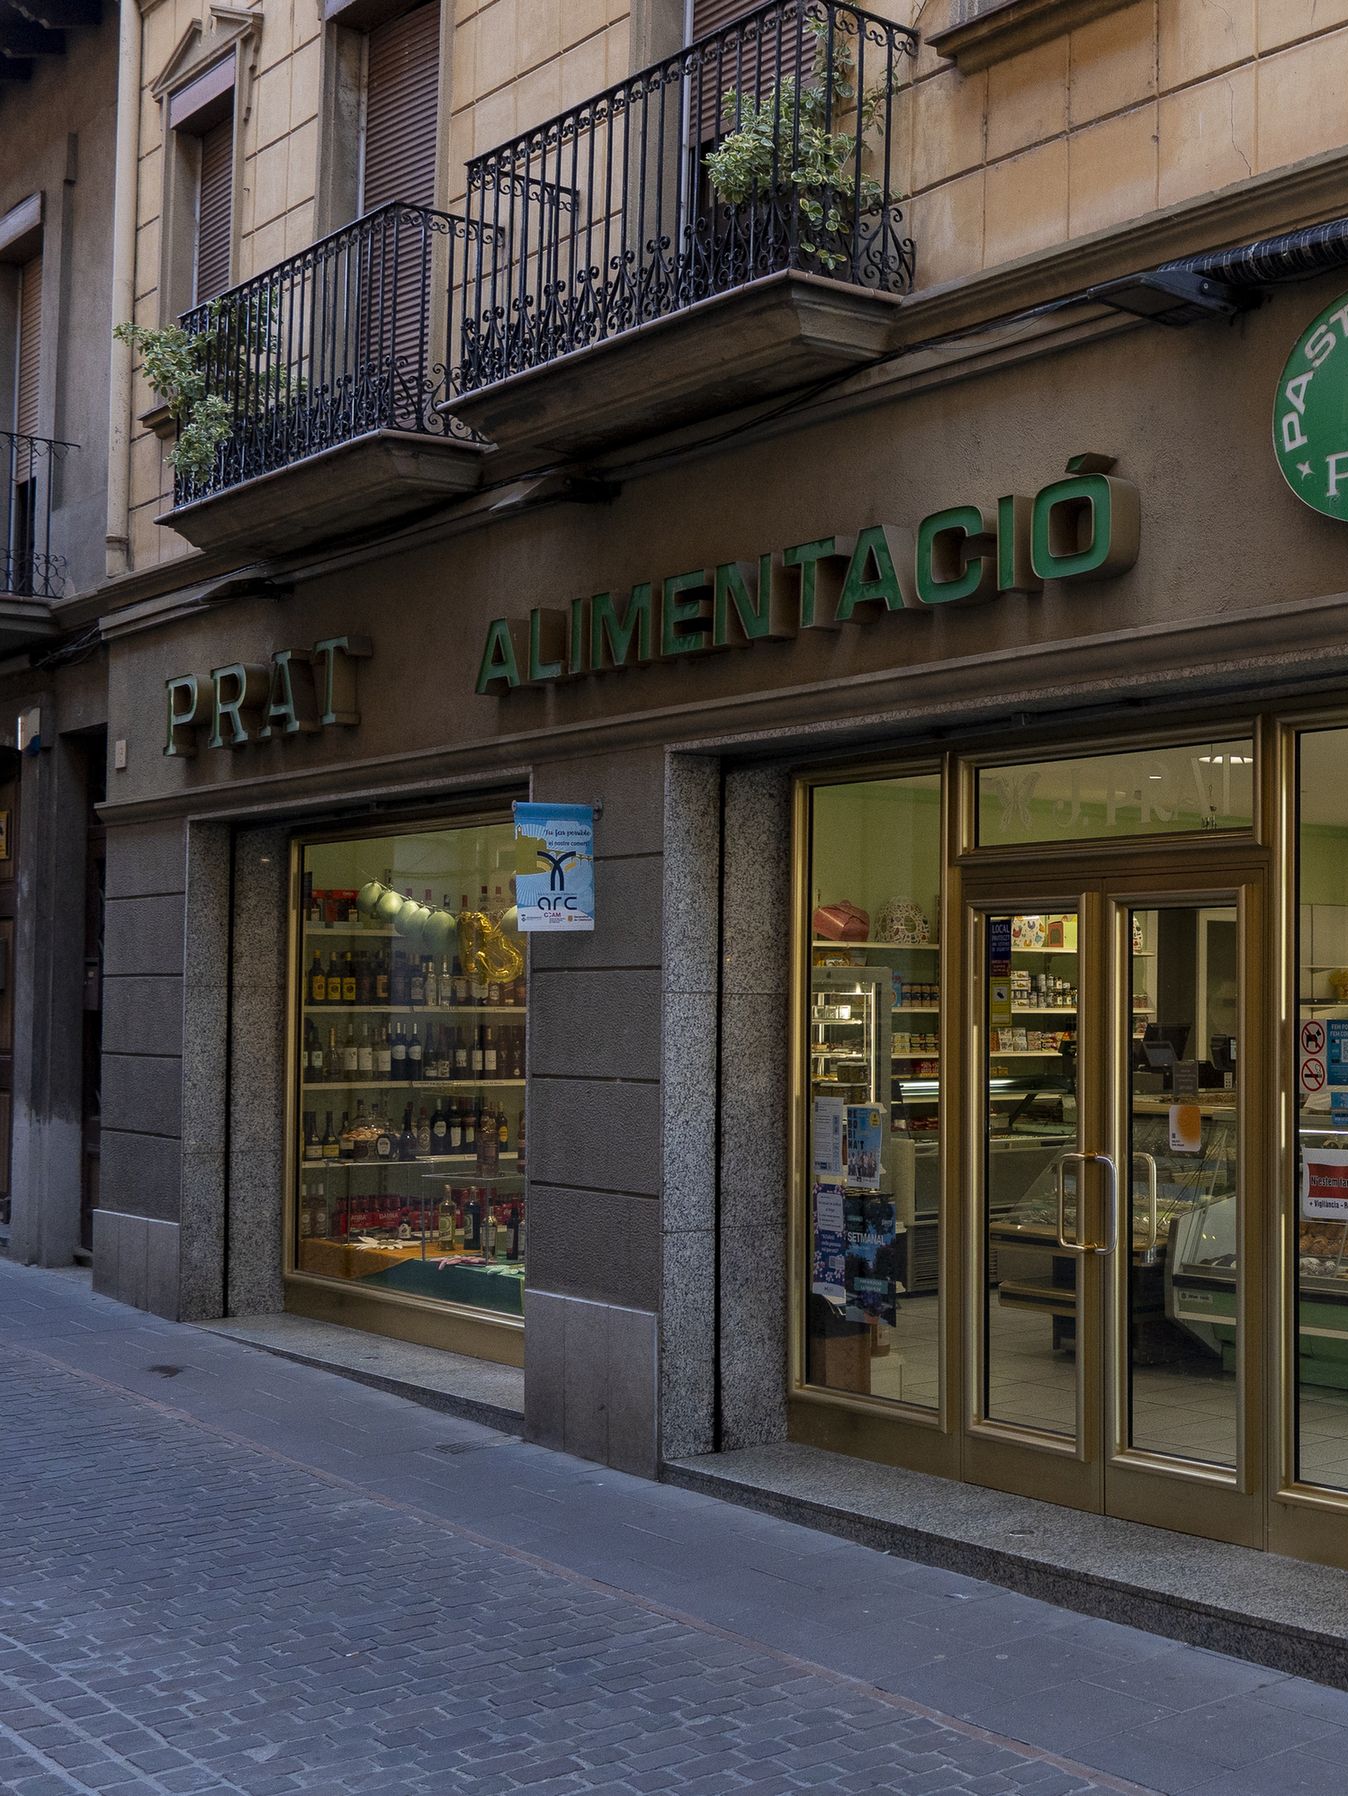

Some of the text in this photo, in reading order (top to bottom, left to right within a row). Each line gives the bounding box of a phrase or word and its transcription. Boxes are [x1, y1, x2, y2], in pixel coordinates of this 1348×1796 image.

[163, 453, 1122, 757] PRAT ALIMENTACIÓ
[537, 896, 577, 911] arc
[991, 924, 1010, 934] LOCAL
[847, 1232, 886, 1246] SETMANAL
